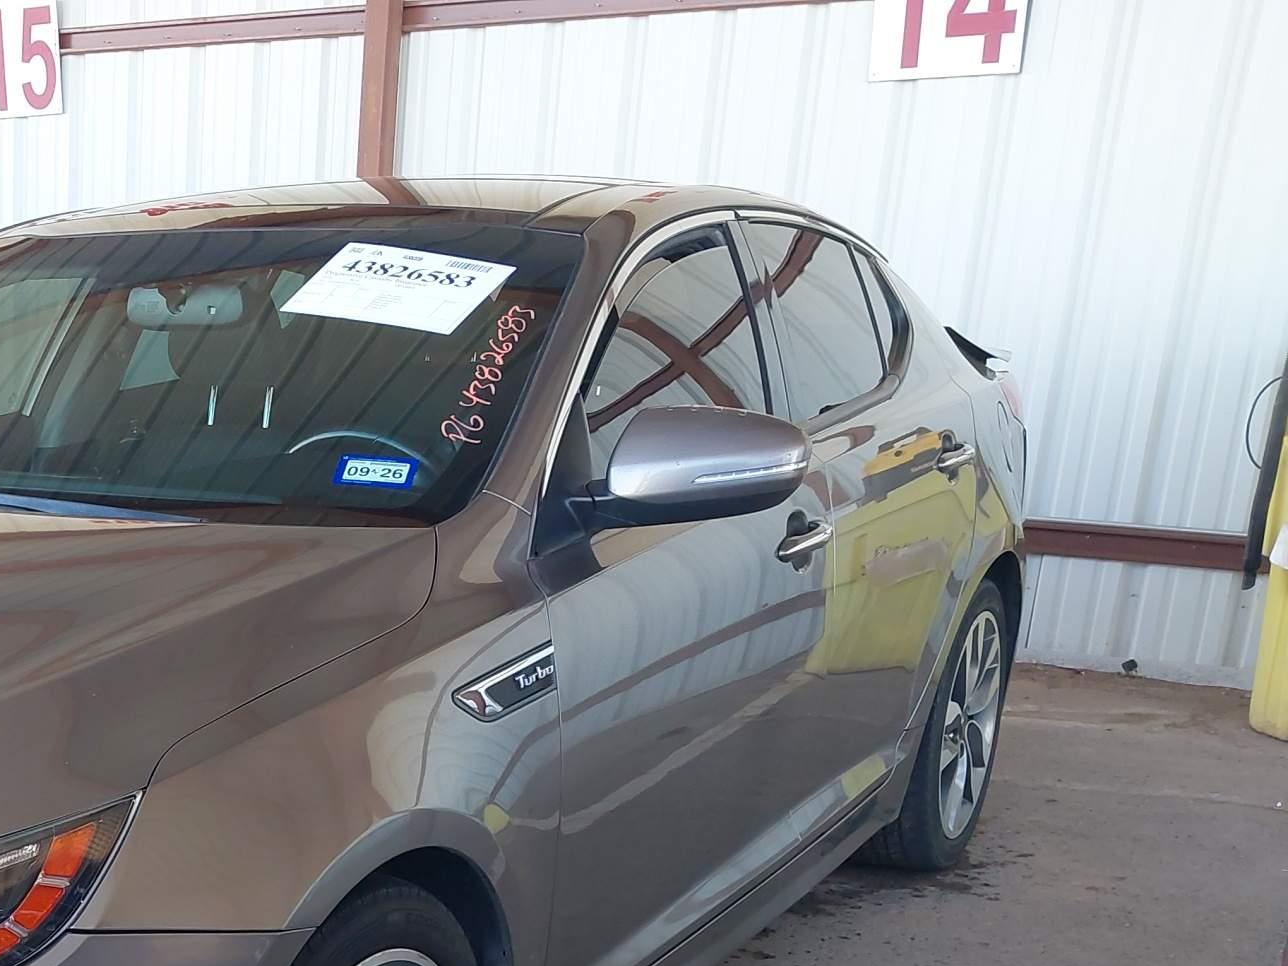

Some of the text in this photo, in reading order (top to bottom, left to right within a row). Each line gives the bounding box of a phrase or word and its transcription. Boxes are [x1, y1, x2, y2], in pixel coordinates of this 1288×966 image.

[342, 259, 476, 288] 43826583
[458, 305, 536, 407] 43826583
[347, 466, 404, 479] 09 26
[515, 664, 554, 689] Turbo
